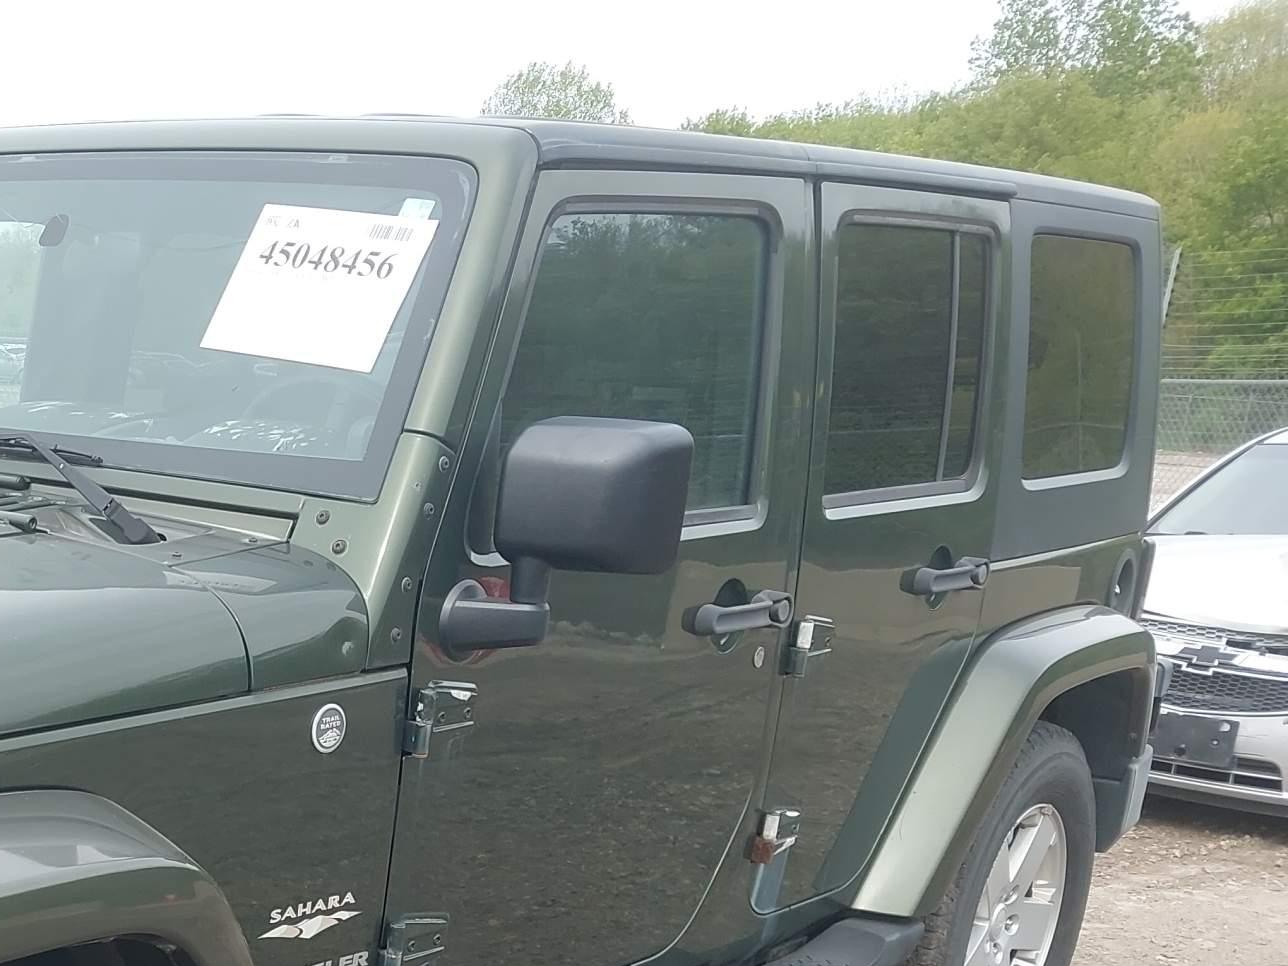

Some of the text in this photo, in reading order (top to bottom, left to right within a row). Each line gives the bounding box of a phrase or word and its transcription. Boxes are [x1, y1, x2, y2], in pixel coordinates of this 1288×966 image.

[259, 240, 400, 280] 45048456
[320, 720, 341, 730] RATED
[321, 715, 340, 724] TRAIL
[269, 891, 356, 924] SAHARA
